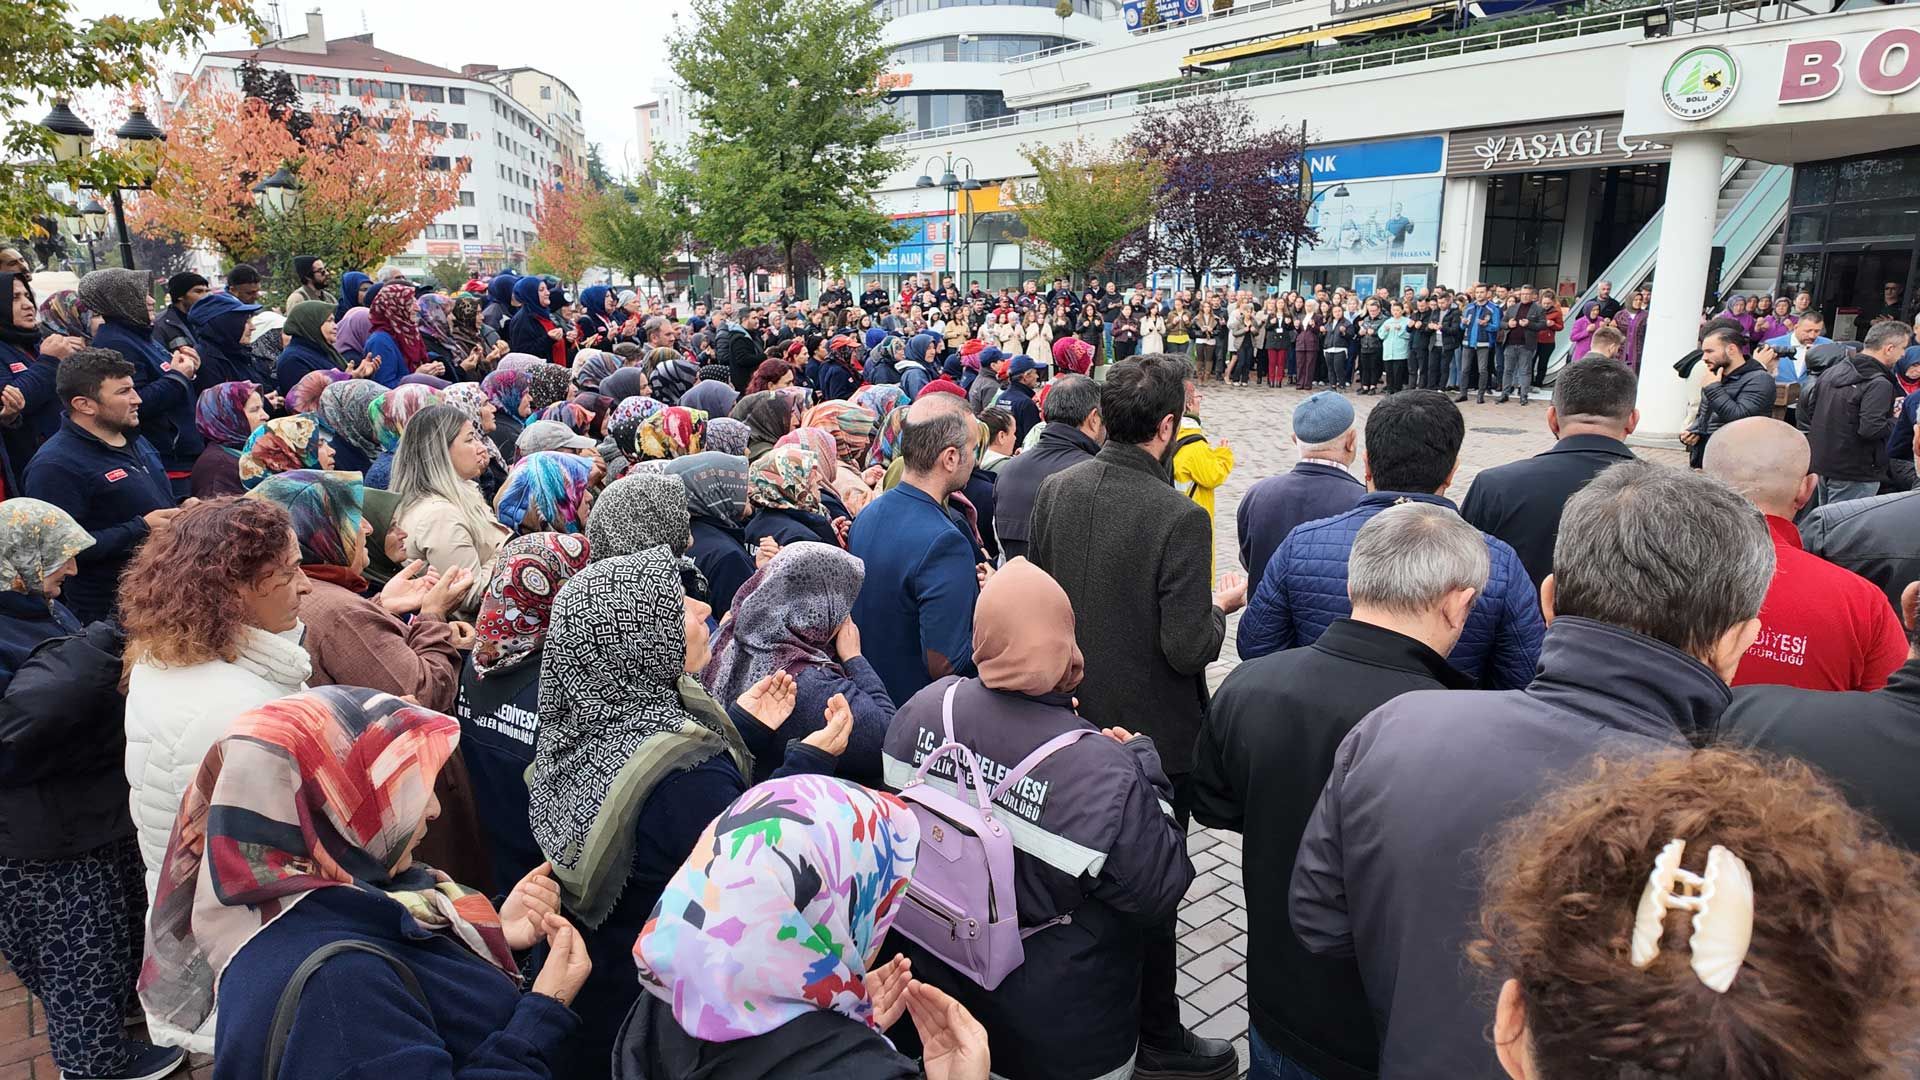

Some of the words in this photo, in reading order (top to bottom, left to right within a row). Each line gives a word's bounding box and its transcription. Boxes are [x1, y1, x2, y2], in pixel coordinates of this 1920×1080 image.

[1778, 27, 1920, 105] BO
[1665, 93, 1689, 114] BELEDİYE
[1692, 86, 1731, 114] BAŞKANLIĞI
[1686, 95, 1708, 103] BOLU
[1506, 125, 1605, 166] AŞAĞI
[900, 252, 921, 265] ALIN
[1746, 646, 1804, 666] DÜRLÜĞÜ
[494, 703, 540, 732] LEDİYESİ
[974, 753, 1049, 806] BELEYESİ
